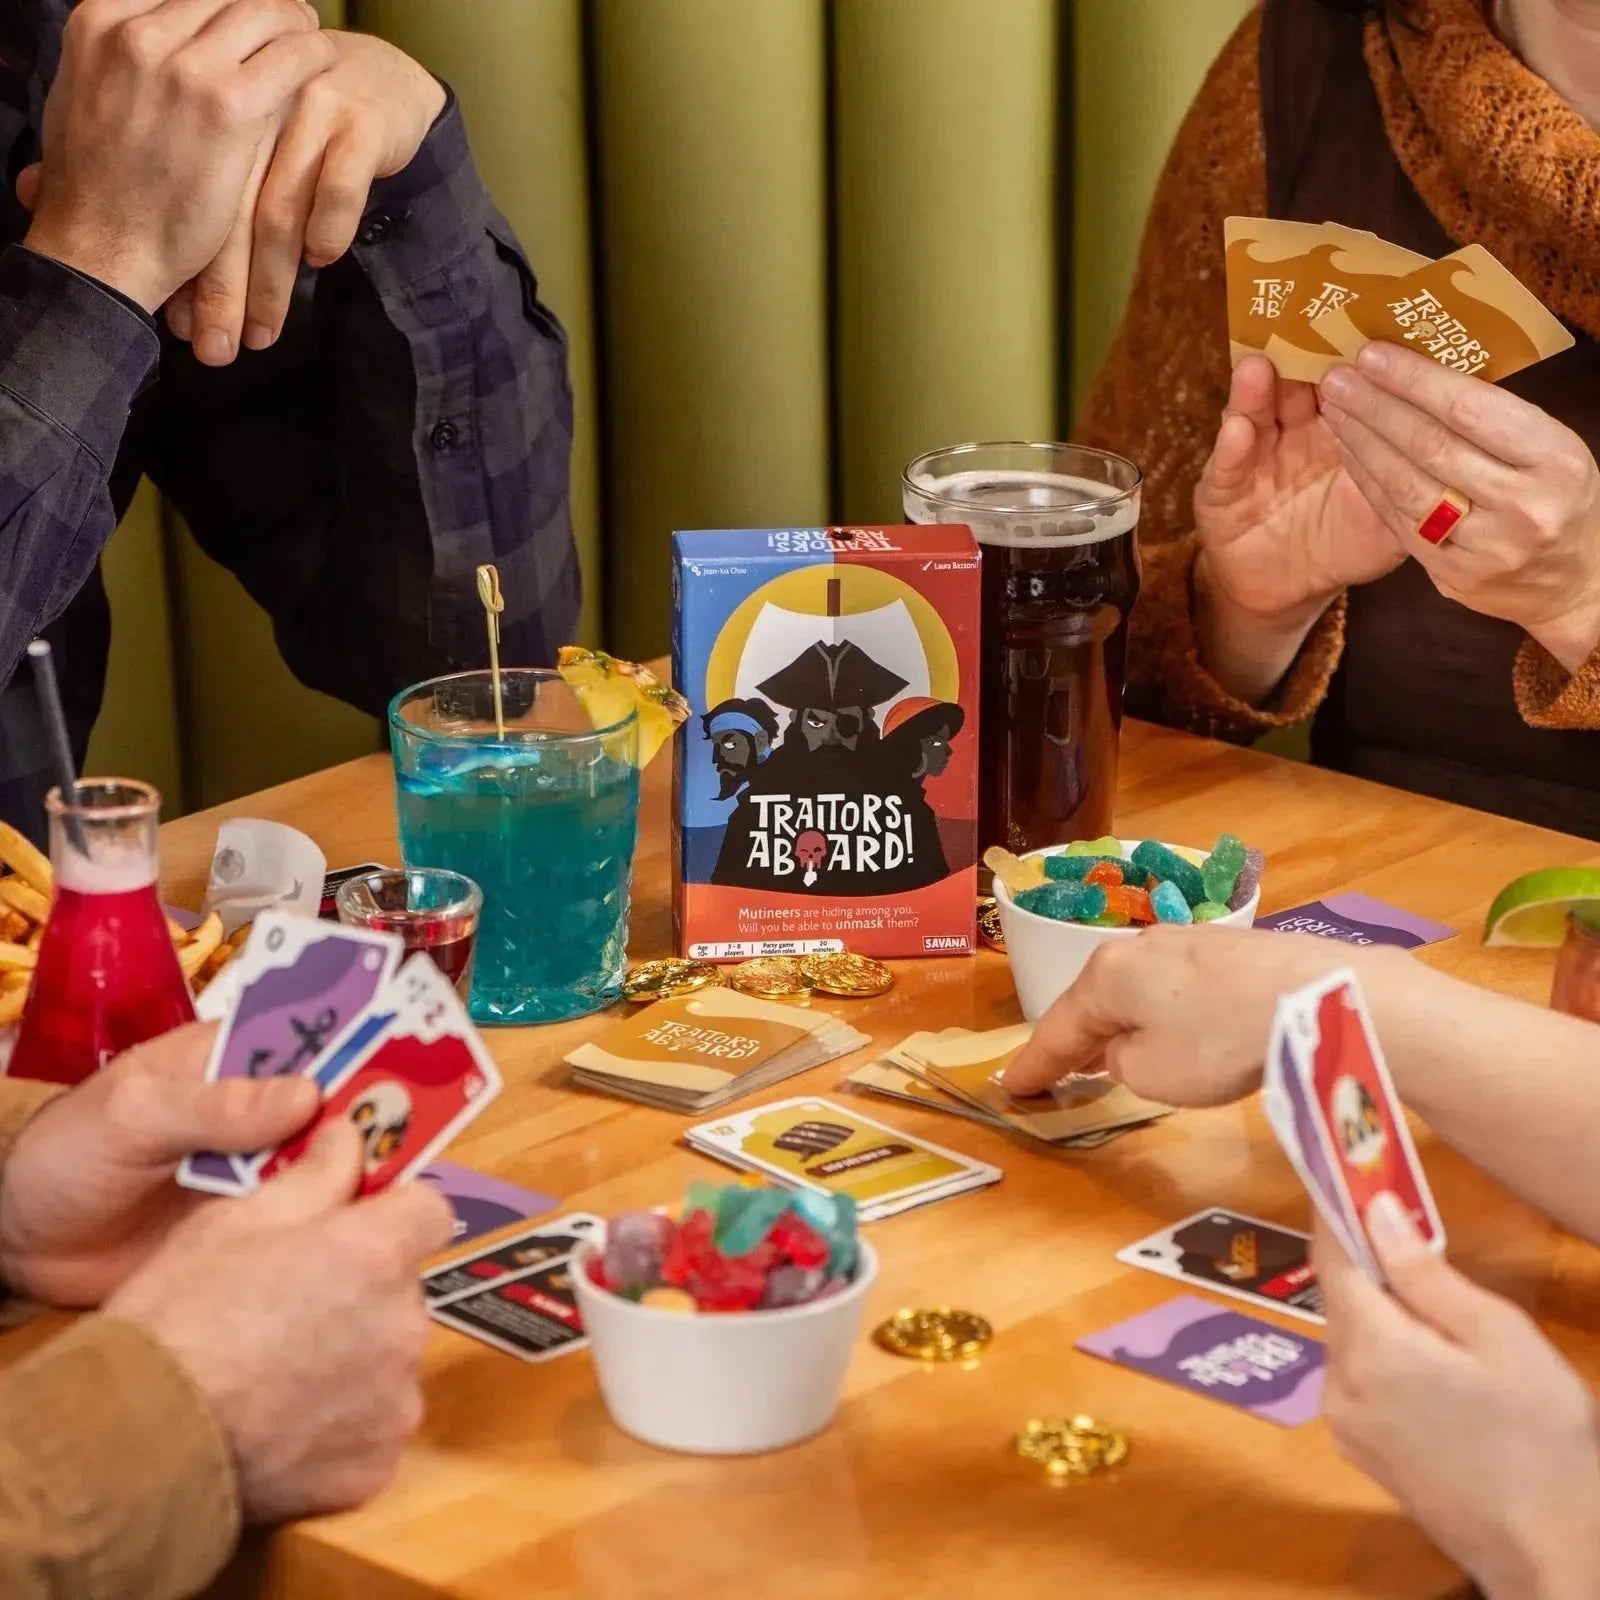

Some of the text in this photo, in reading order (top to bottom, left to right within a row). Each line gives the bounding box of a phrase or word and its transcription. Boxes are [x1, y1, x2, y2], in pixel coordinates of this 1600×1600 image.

[1412, 288, 1490, 364] TRAITORS
[776, 539, 903, 552] TRAITORS
[730, 566, 747, 575] Chou
[934, 561, 976, 570] Laura Bazzoni
[749, 793, 903, 839] TRAITORS
[738, 907, 800, 920] Mutineers
[803, 909, 819, 918] are
[822, 907, 852, 919] hiding
[855, 907, 890, 918] among
[738, 917, 919, 936] Will you be able to unmask them?
[697, 944, 708, 952] Age
[925, 937, 967, 949] SAVANA
[660, 1020, 760, 1050] TRAITORS
